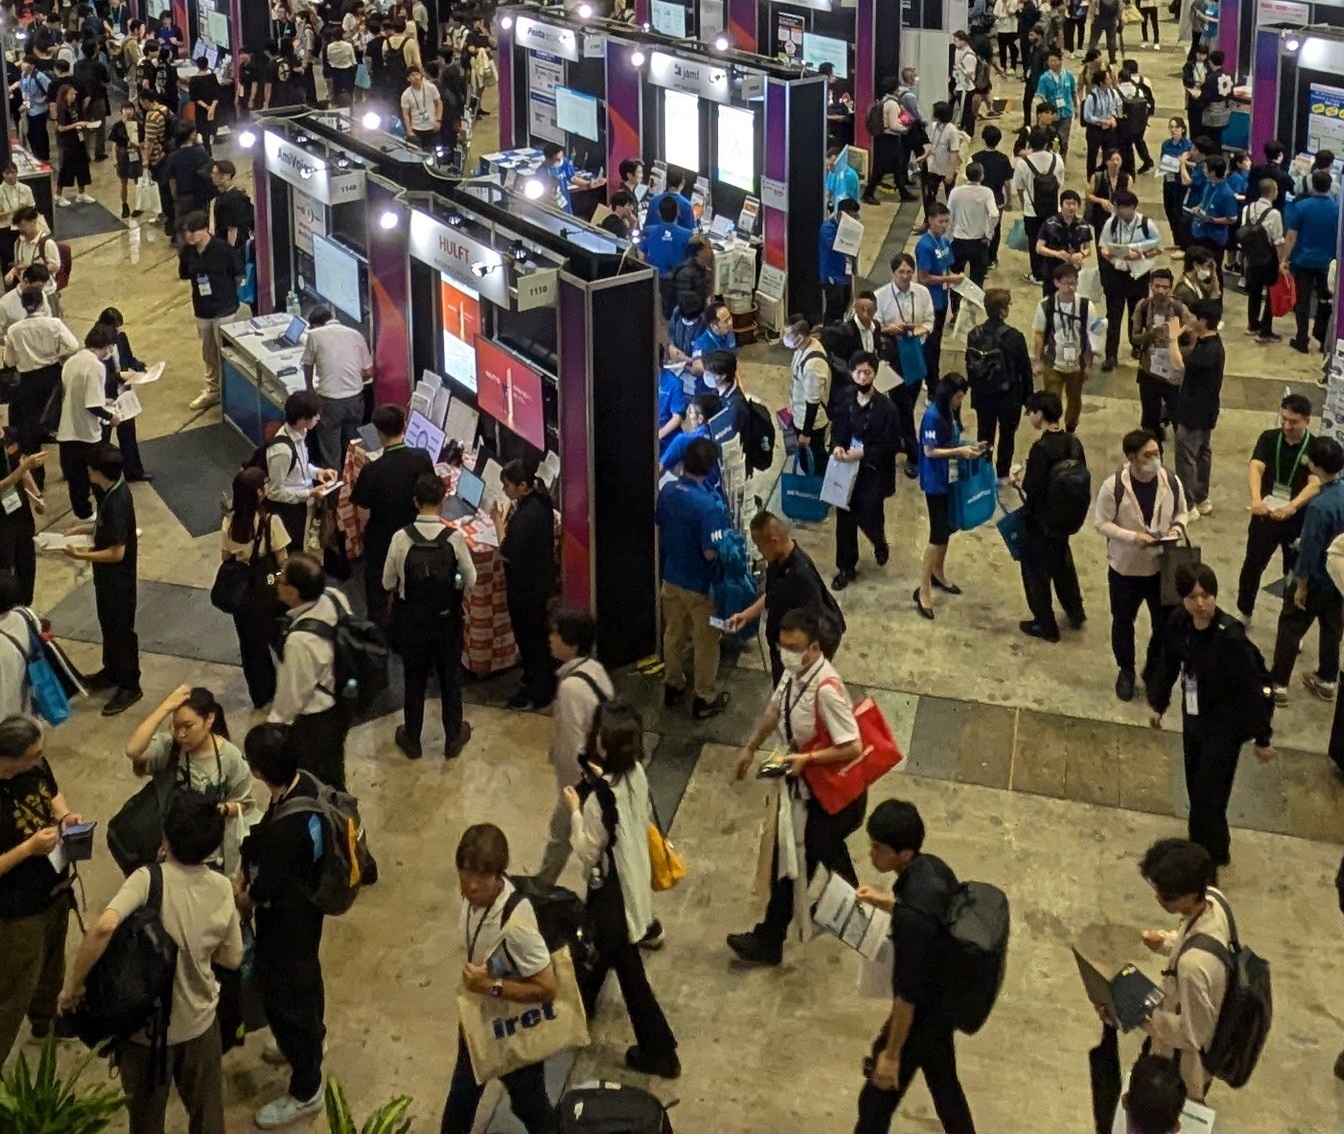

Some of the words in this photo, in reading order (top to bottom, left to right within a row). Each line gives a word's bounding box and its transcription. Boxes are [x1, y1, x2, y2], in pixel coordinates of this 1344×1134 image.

[682, 66, 700, 81] jamf
[277, 147, 314, 173] AmiVoi
[439, 235, 470, 264] HULFT
[493, 1001, 557, 1040] iret
